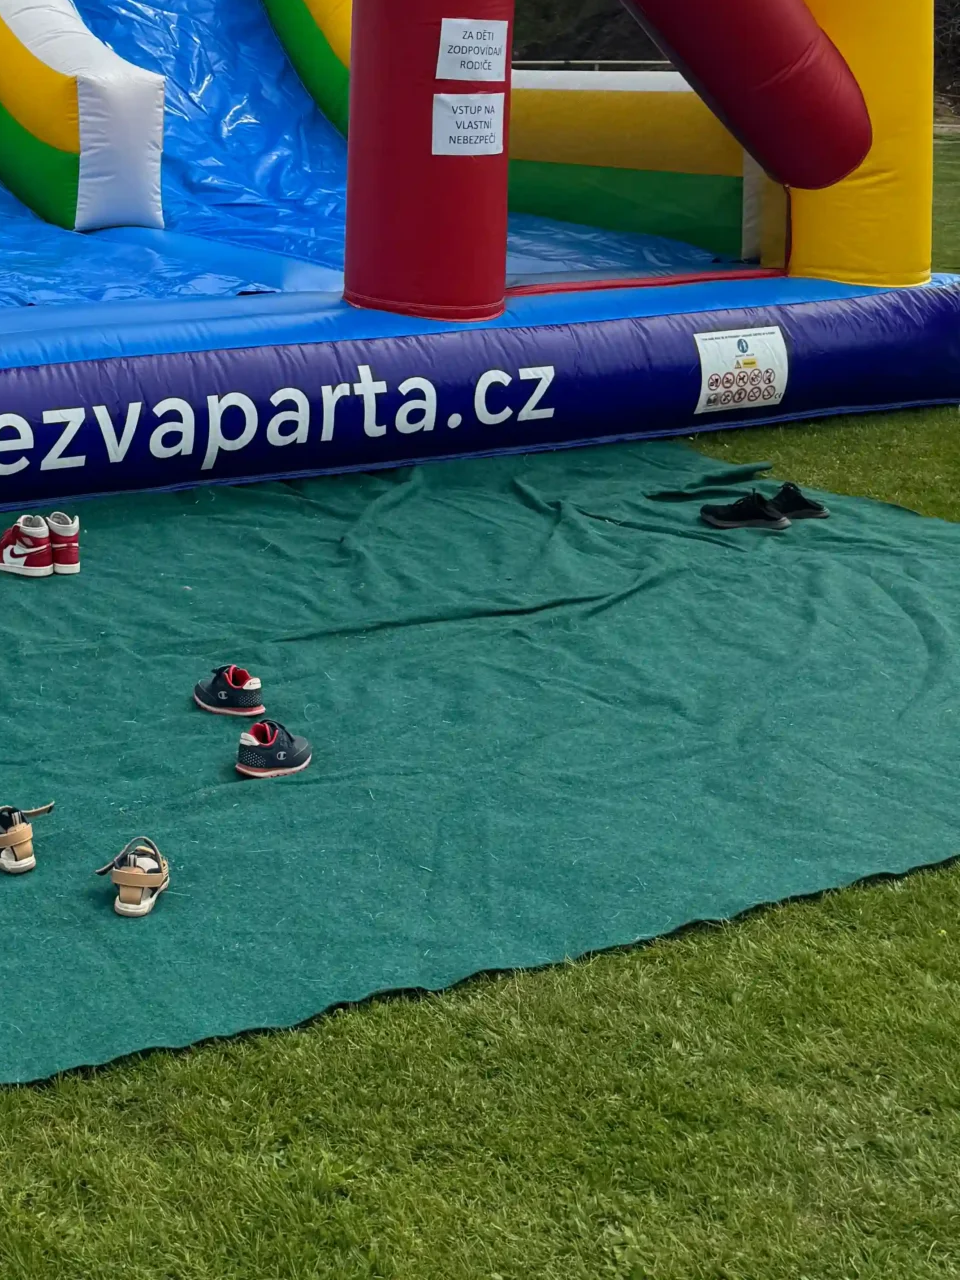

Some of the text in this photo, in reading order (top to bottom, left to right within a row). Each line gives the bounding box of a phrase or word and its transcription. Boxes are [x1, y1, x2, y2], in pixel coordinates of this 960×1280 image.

[462, 29, 494, 41] ZA DĚTI
[460, 59, 492, 70] RODIČE
[451, 105, 495, 115] VSTUP NA
[455, 118, 492, 130] VLASTNÍ
[448, 132, 496, 144] NEBEZPEČÍ
